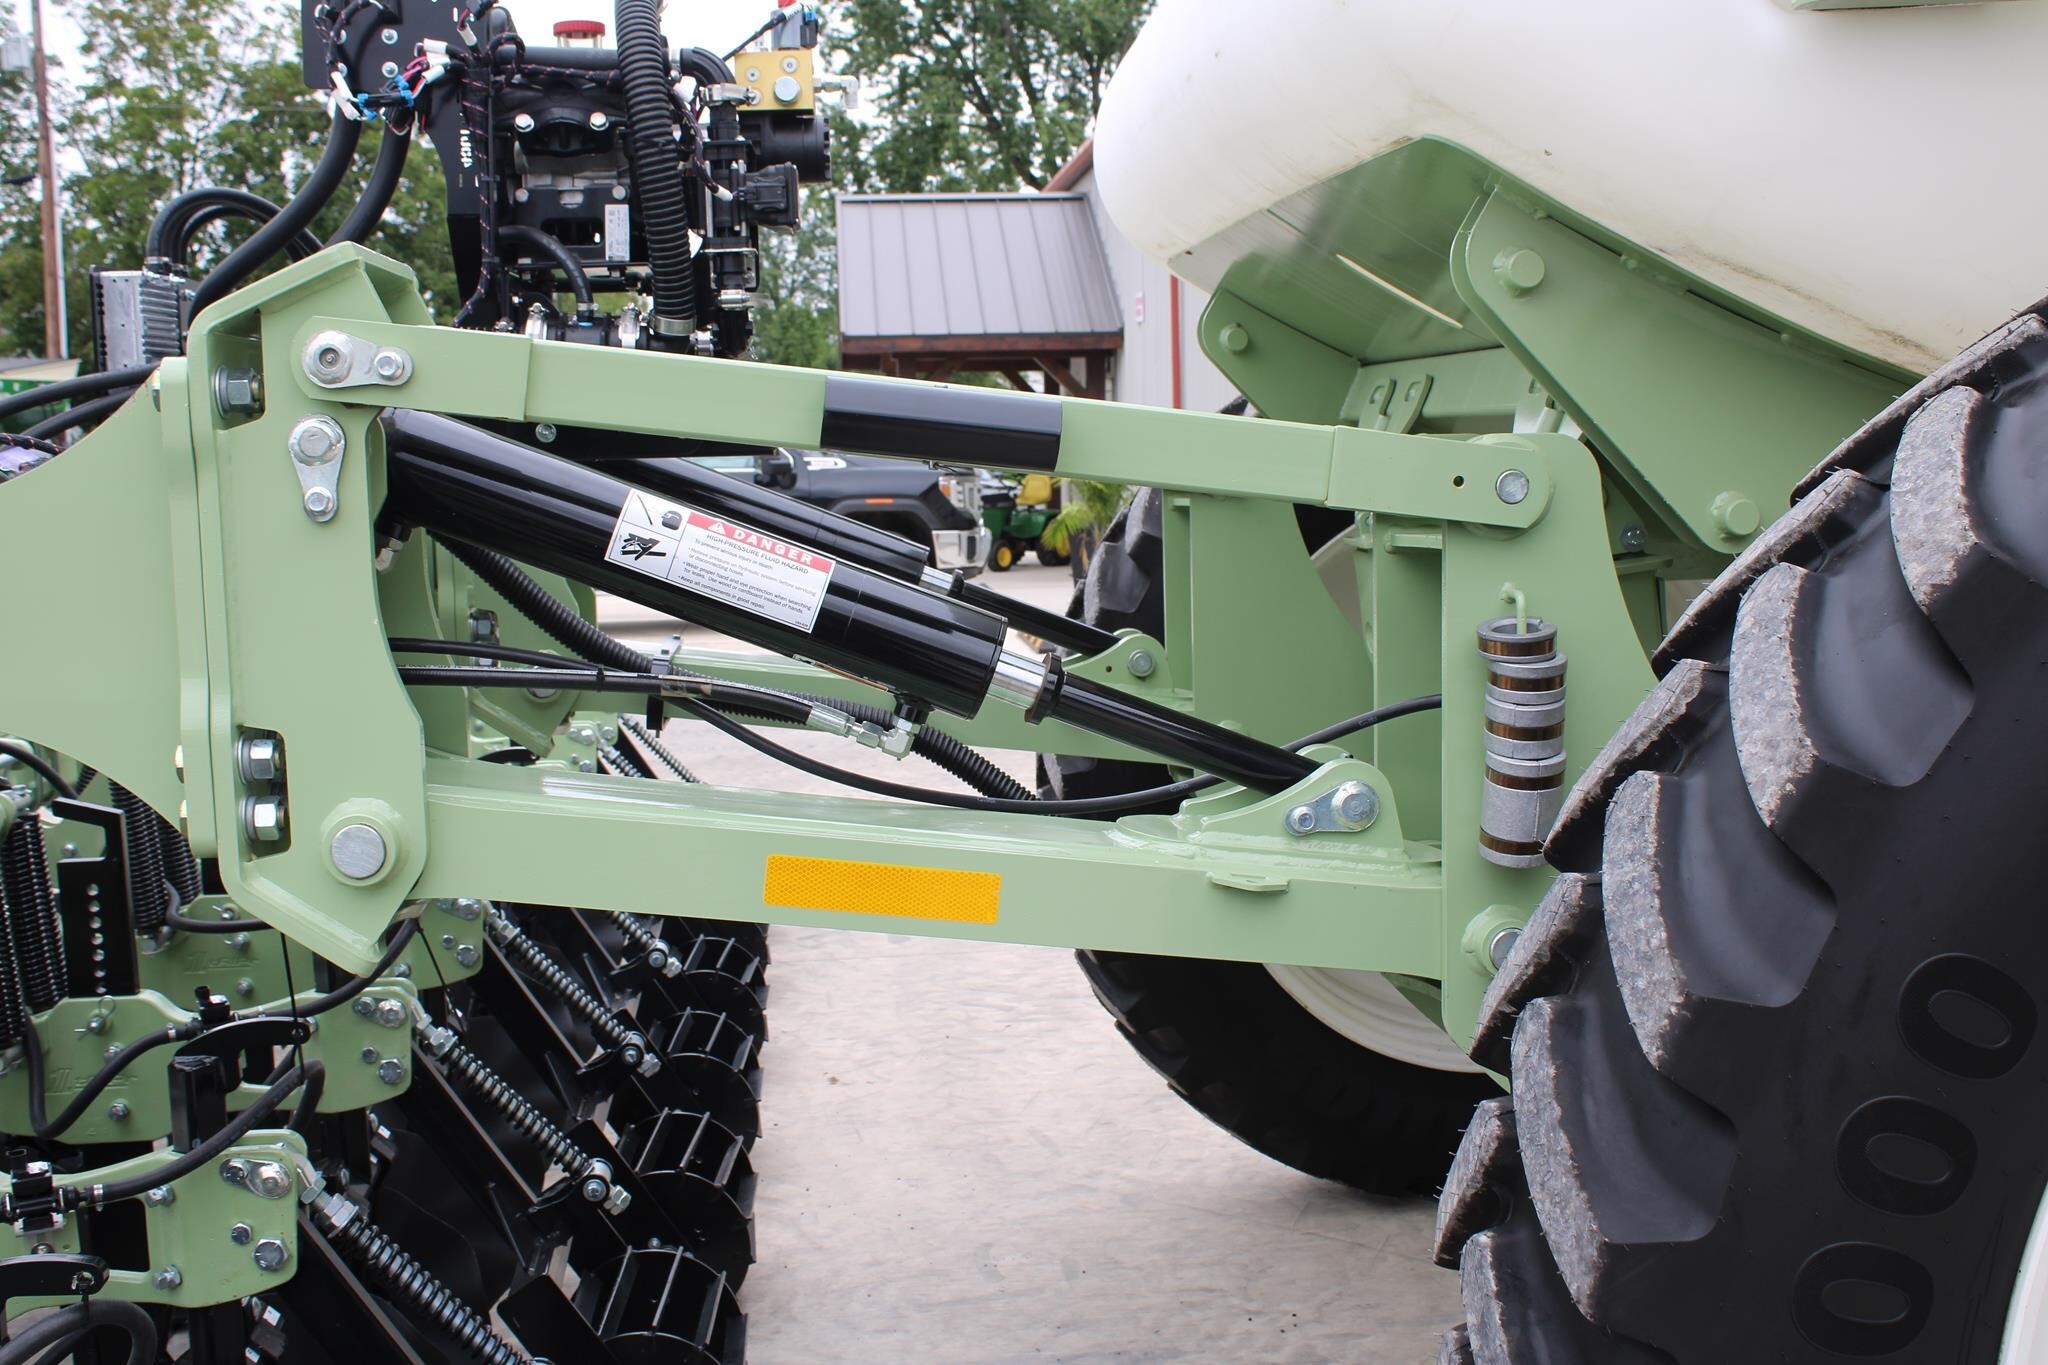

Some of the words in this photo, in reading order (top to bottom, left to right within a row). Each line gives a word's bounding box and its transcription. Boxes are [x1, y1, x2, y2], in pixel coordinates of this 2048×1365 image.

[694, 555, 728, 571] disconnecting
[700, 541, 720, 551] prevent
[719, 547, 738, 557] serious
[705, 533, 760, 557] HIGH-PRESSURE
[760, 553, 780, 564] FLUID
[780, 560, 809, 574] HAZARD
[731, 528, 814, 565] DANGER
[680, 575, 694, 584] Keep
[699, 582, 731, 598] components
[736, 595, 750, 605] good
[685, 561, 699, 570] Wear
[699, 566, 715, 576] proper
[715, 572, 729, 580] hand
[748, 584, 773, 597] protection
[773, 593, 788, 601] when
[787, 597, 812, 611] searching
[707, 575, 718, 583] Use
[717, 579, 732, 588] wood
[737, 586, 763, 600] cardboard
[763, 595, 782, 606] instead
[708, 554, 730, 566] pressure
[737, 564, 760, 576] hydraulic
[760, 573, 777, 583] system
[778, 578, 794, 588] before
[794, 584, 816, 596] servicing
